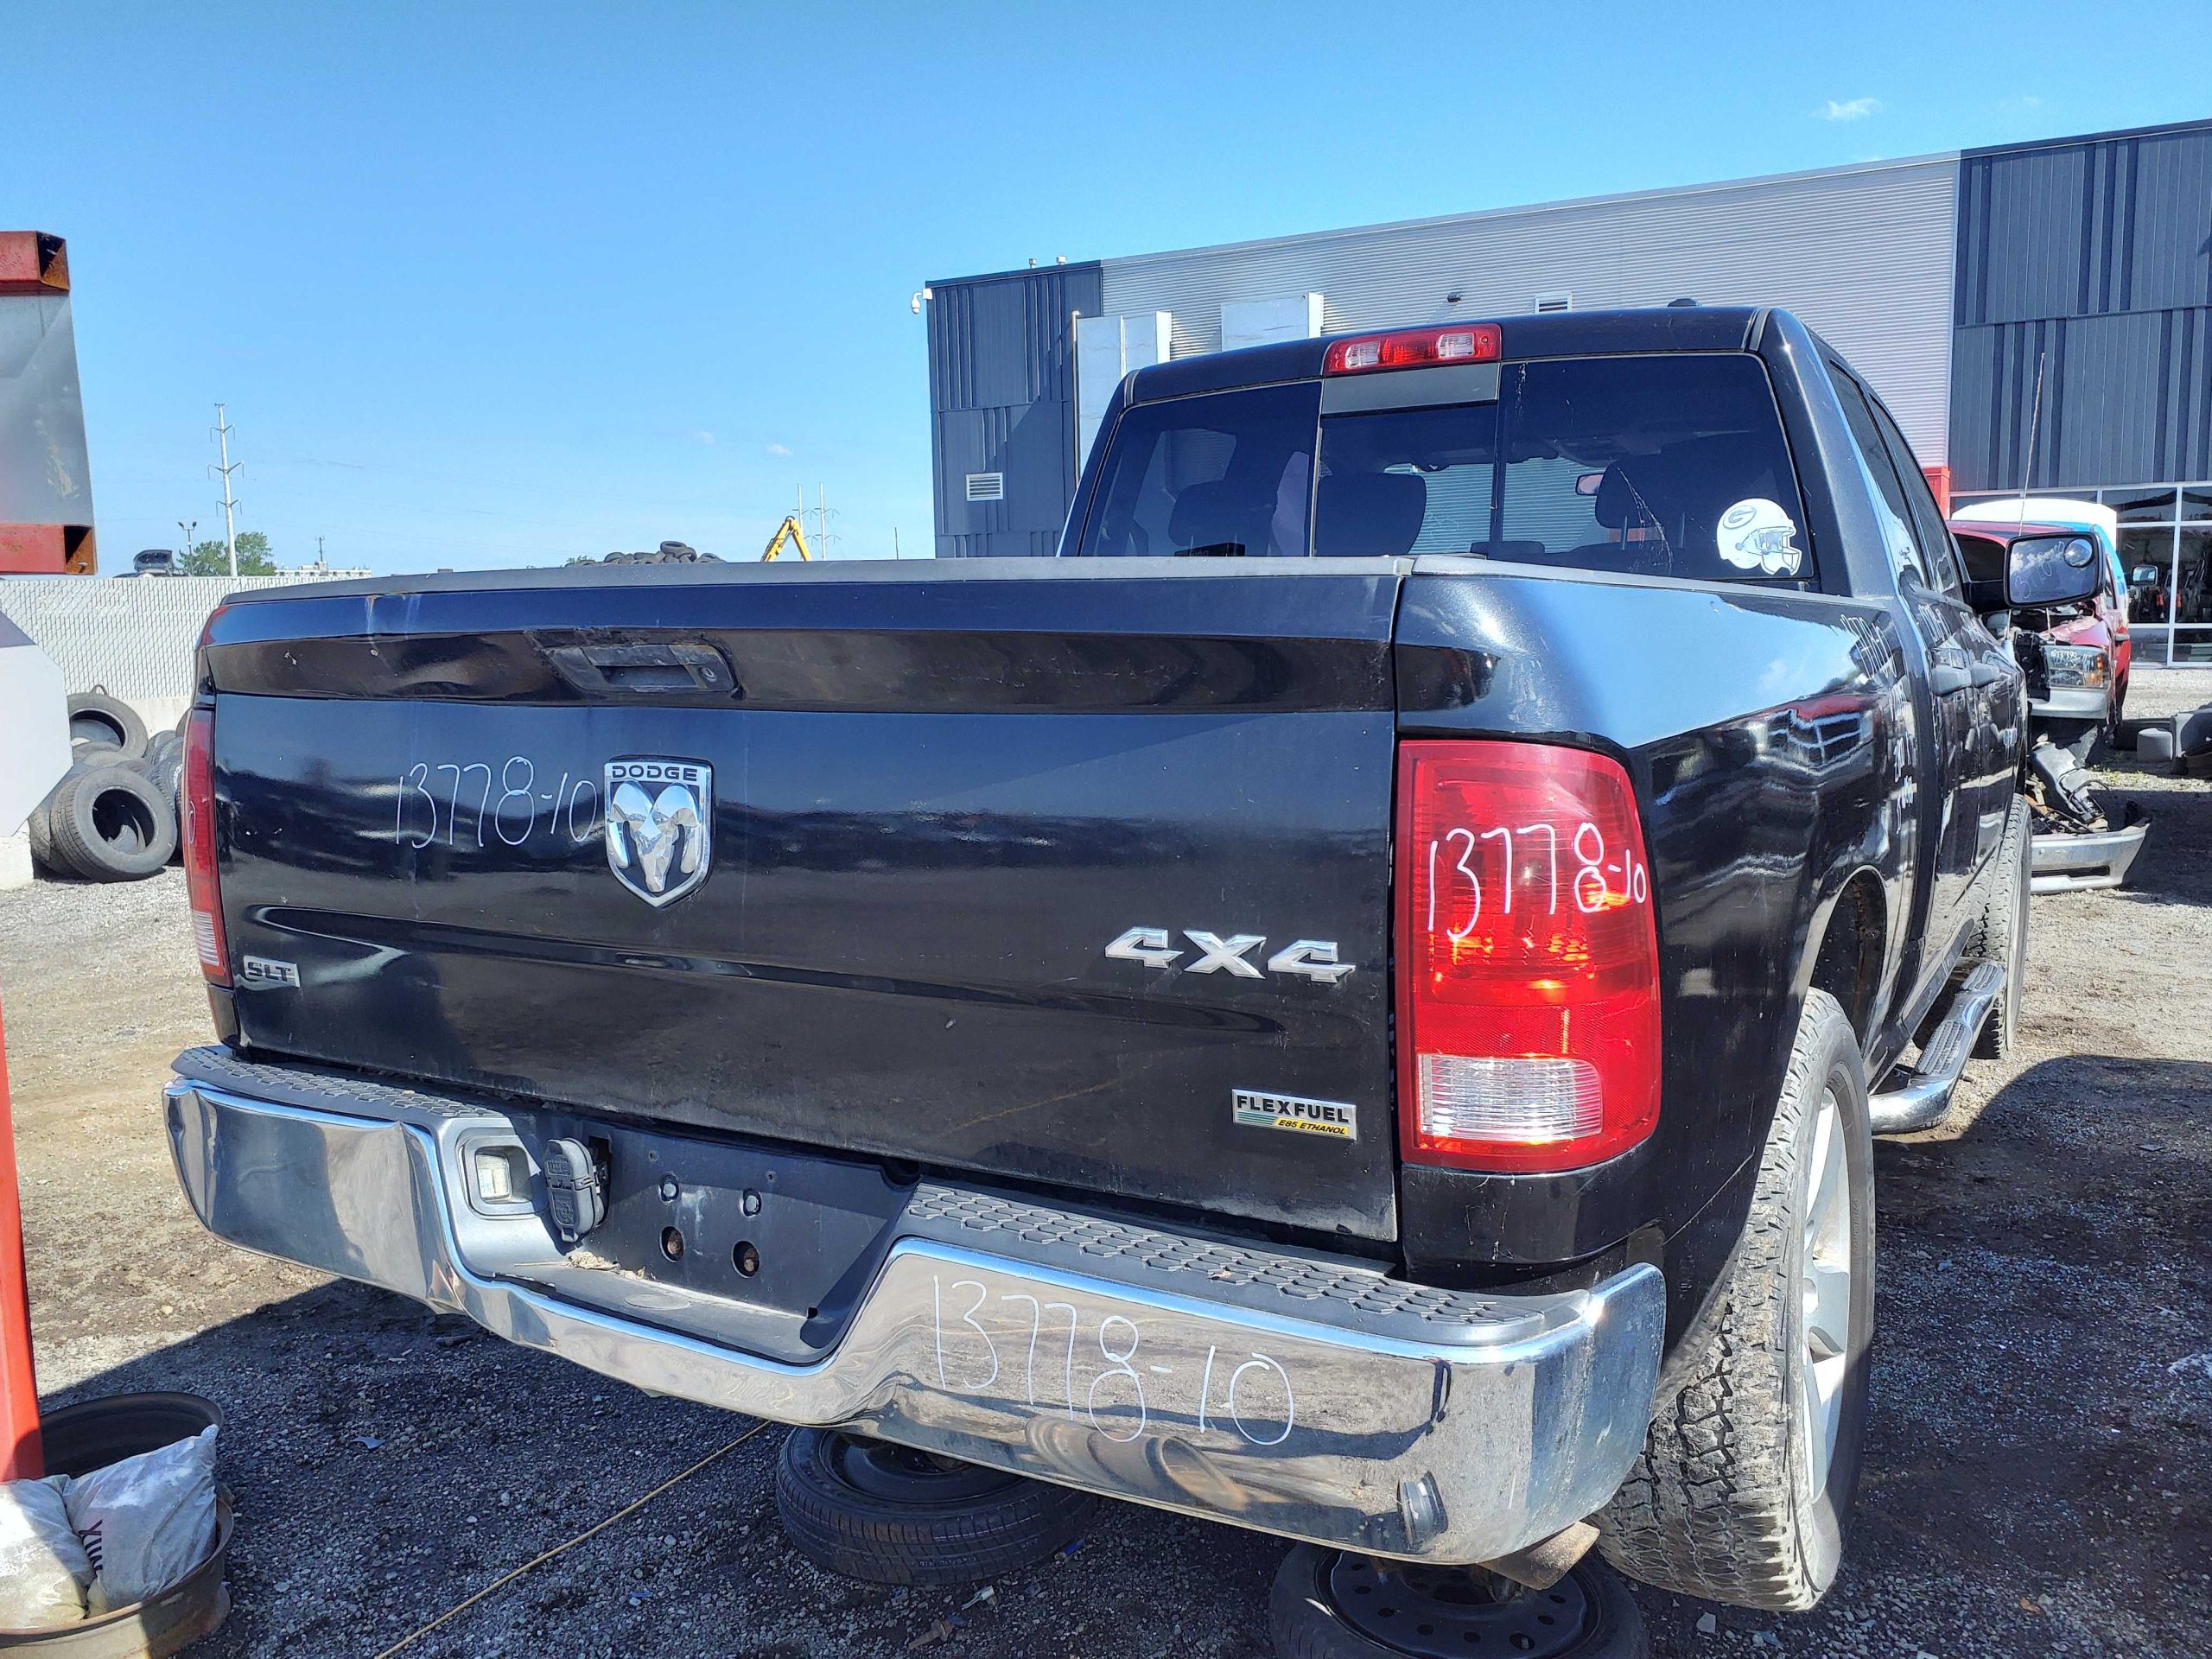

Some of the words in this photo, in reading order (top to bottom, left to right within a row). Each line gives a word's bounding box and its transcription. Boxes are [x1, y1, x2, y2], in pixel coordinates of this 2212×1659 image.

[612, 765, 698, 782] DODGE
[395, 756, 603, 849] 13778-10
[1427, 822, 1647, 939] 13778-10
[247, 962, 291, 982] SLT
[1278, 1119, 1298, 1128] E85
[1300, 1122, 1346, 1135] ETHANOL
[932, 1274, 1295, 1444] 13778-10
